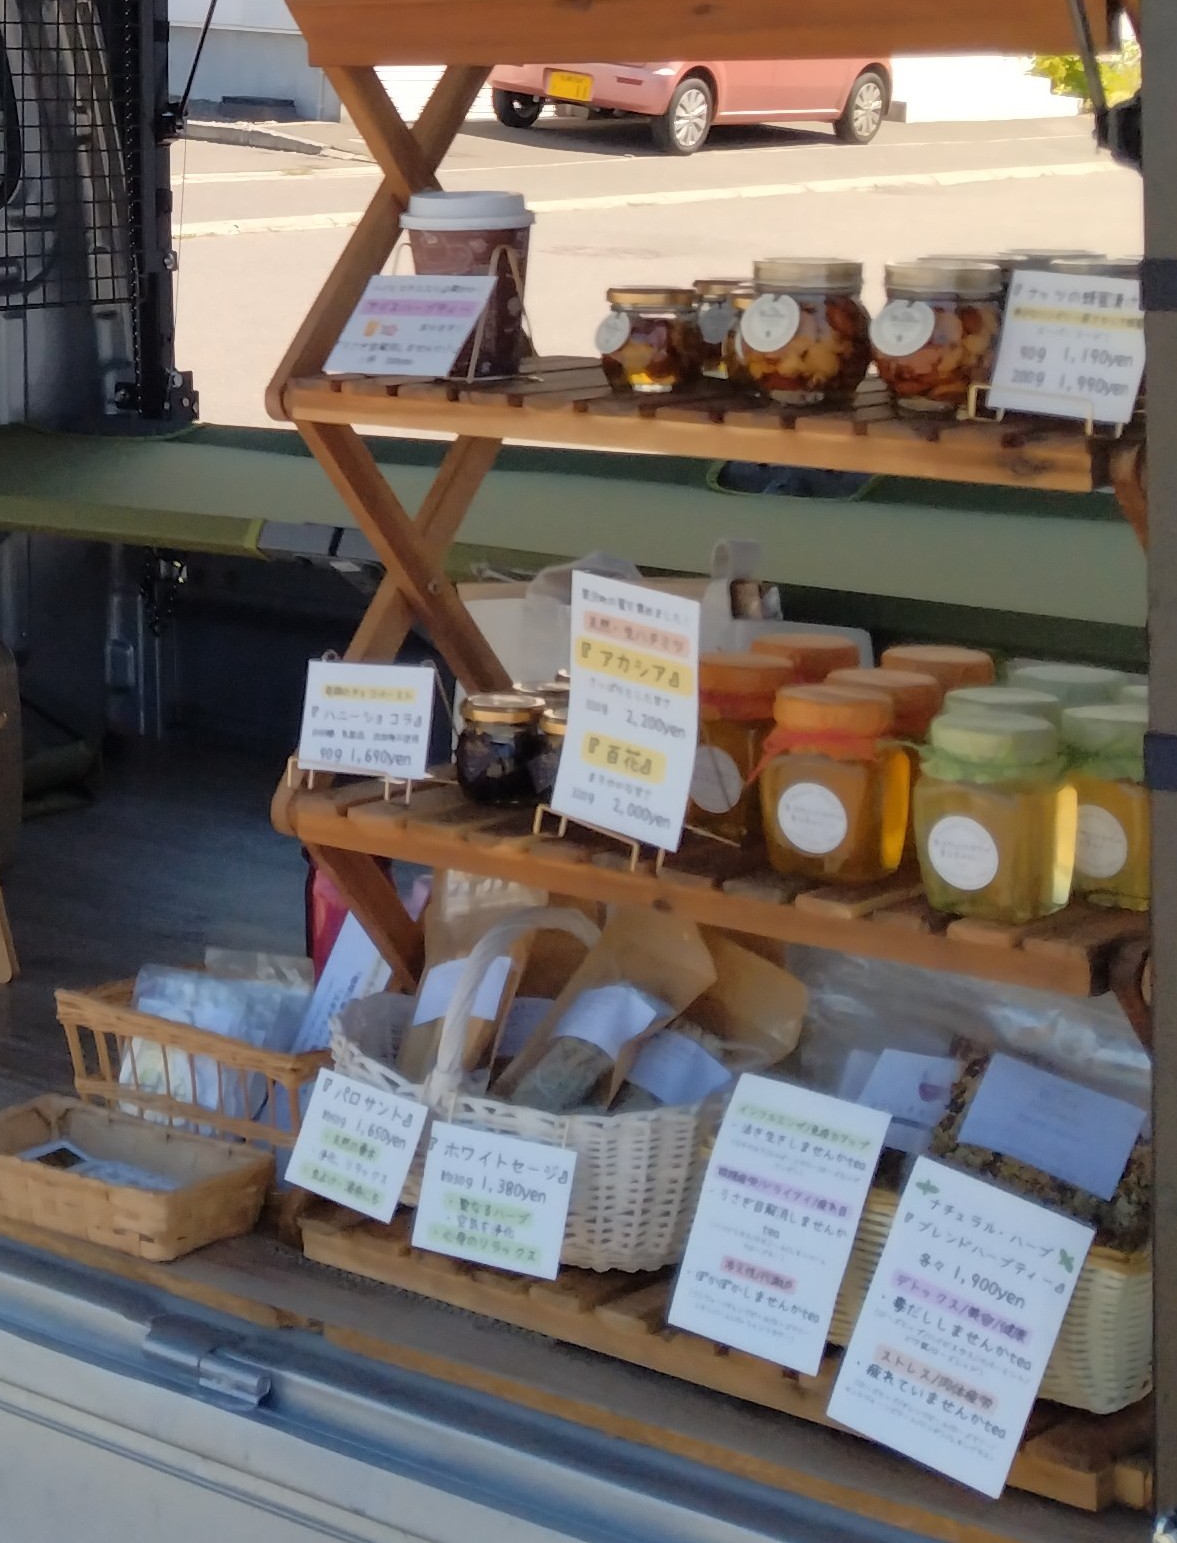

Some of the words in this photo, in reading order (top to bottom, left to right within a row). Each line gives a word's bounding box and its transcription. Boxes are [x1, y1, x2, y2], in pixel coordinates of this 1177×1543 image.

[482, 1176, 547, 1203] 1,380yen
[762, 1224, 780, 1240] tea
[953, 1265, 1026, 1309] 1,900yen
